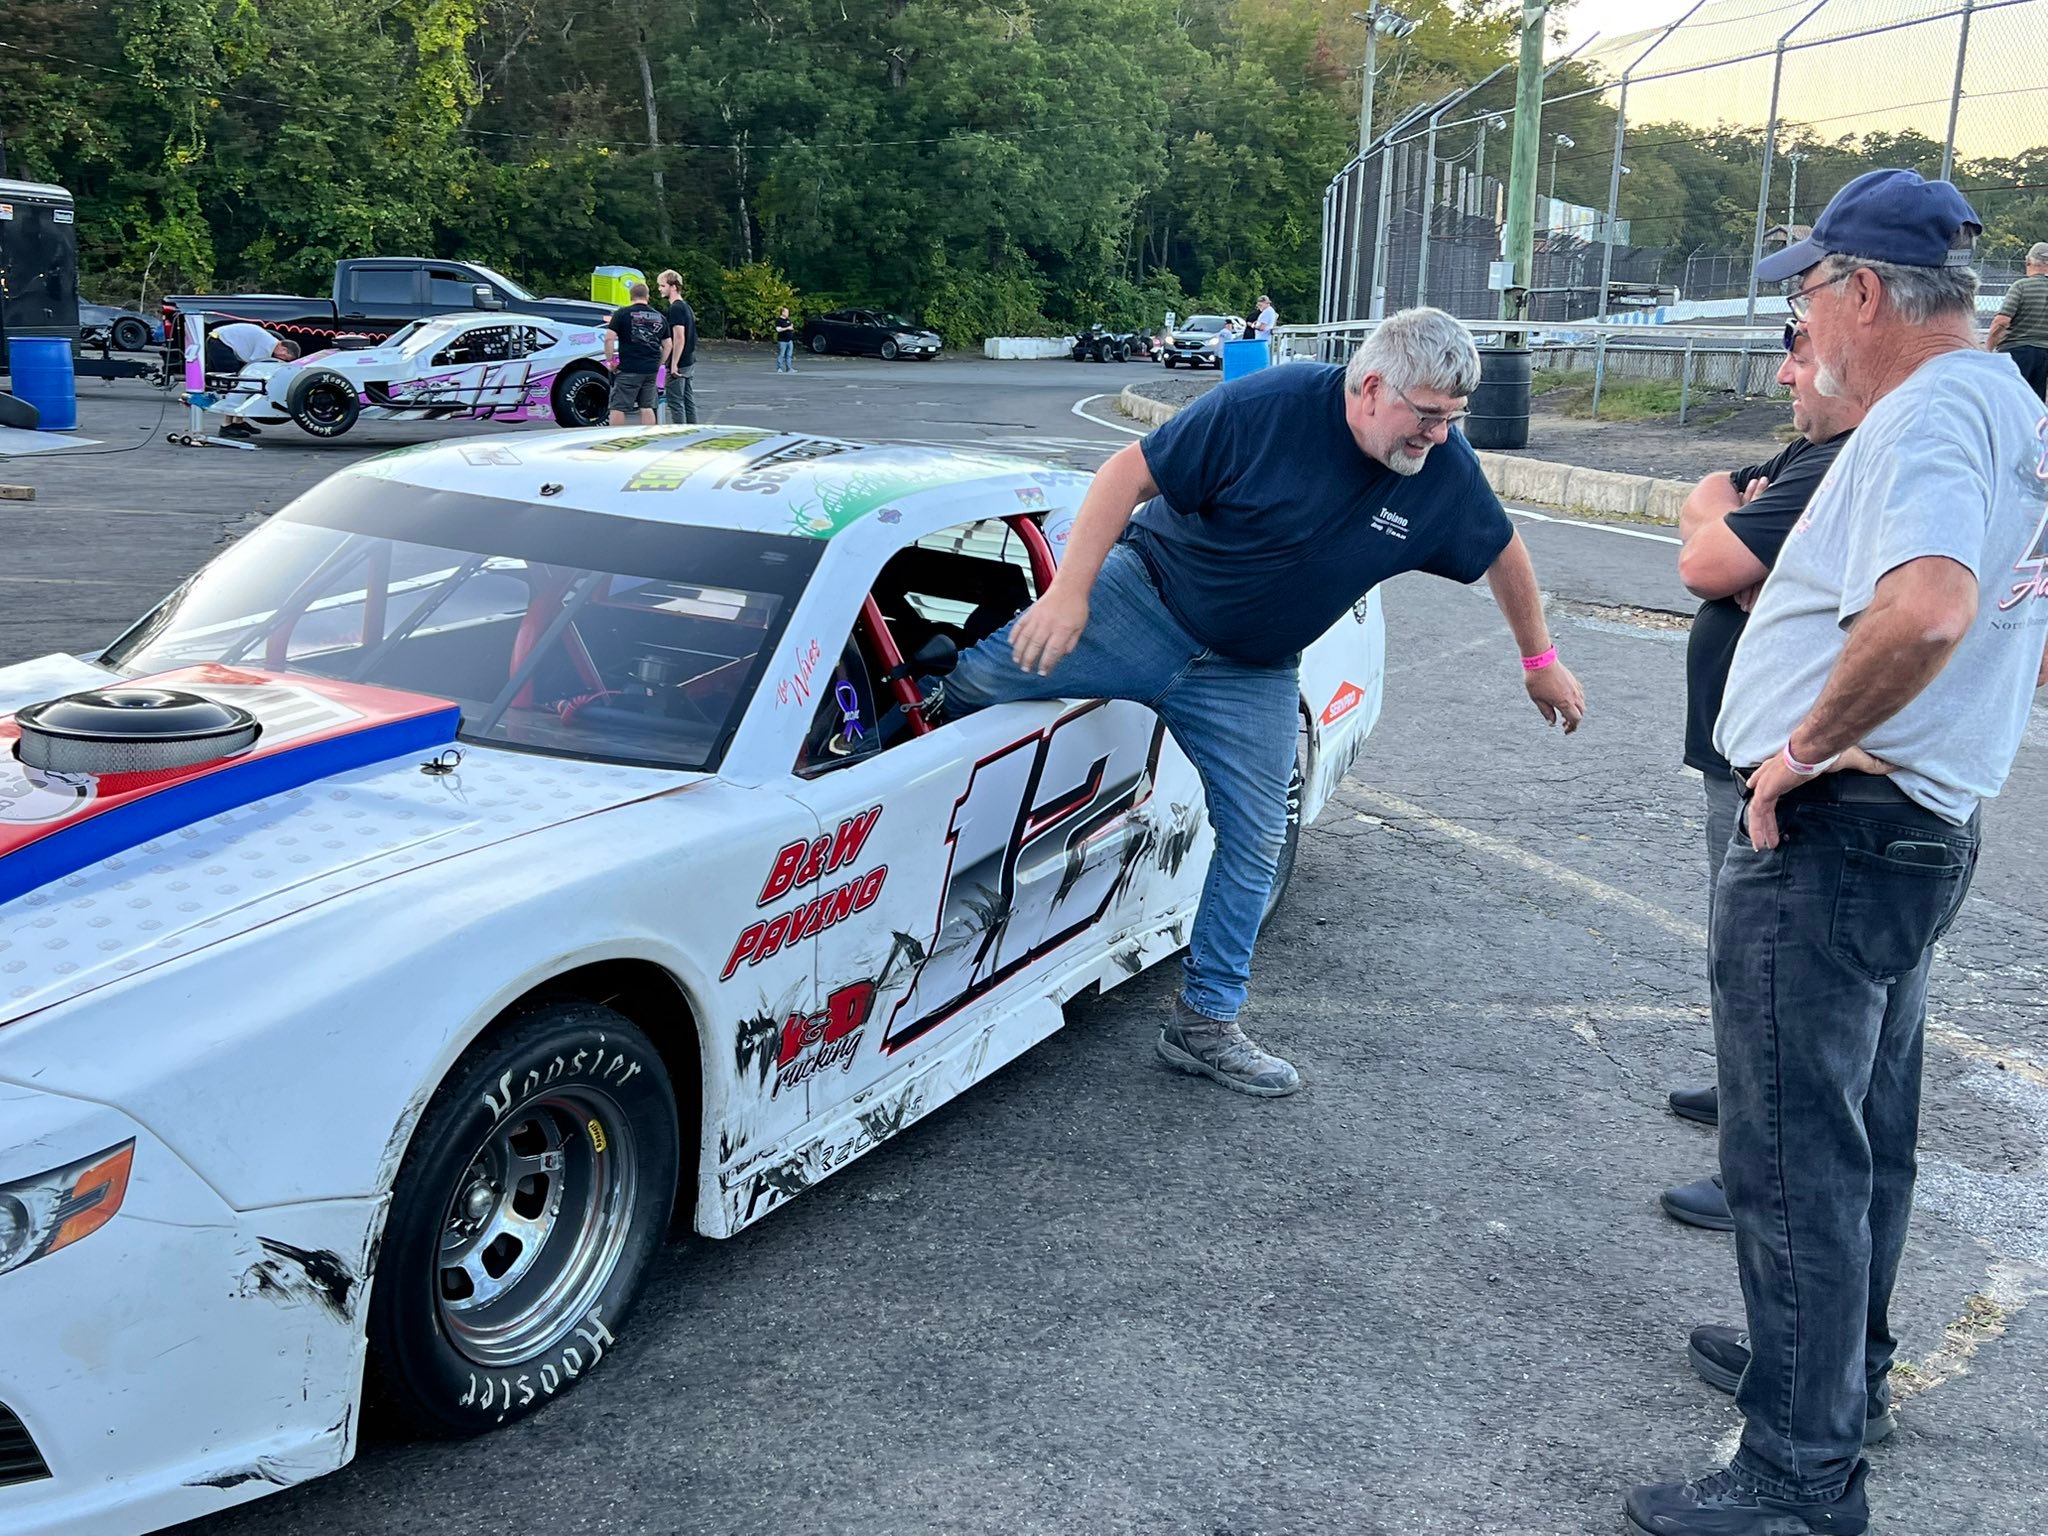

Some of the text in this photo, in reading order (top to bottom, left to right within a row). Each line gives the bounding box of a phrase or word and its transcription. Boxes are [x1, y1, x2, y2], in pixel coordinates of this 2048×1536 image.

[321, 373, 356, 398] Hoosier
[449, 361, 532, 415] 14
[566, 376, 589, 402] Hoosier
[298, 413, 332, 436] Hoosier
[790, 636, 821, 707] Wives
[756, 804, 883, 907] B&W
[880, 698, 1166, 1056] 12
[719, 864, 888, 981] PAVING
[459, 1304, 615, 1423] Hoosier
